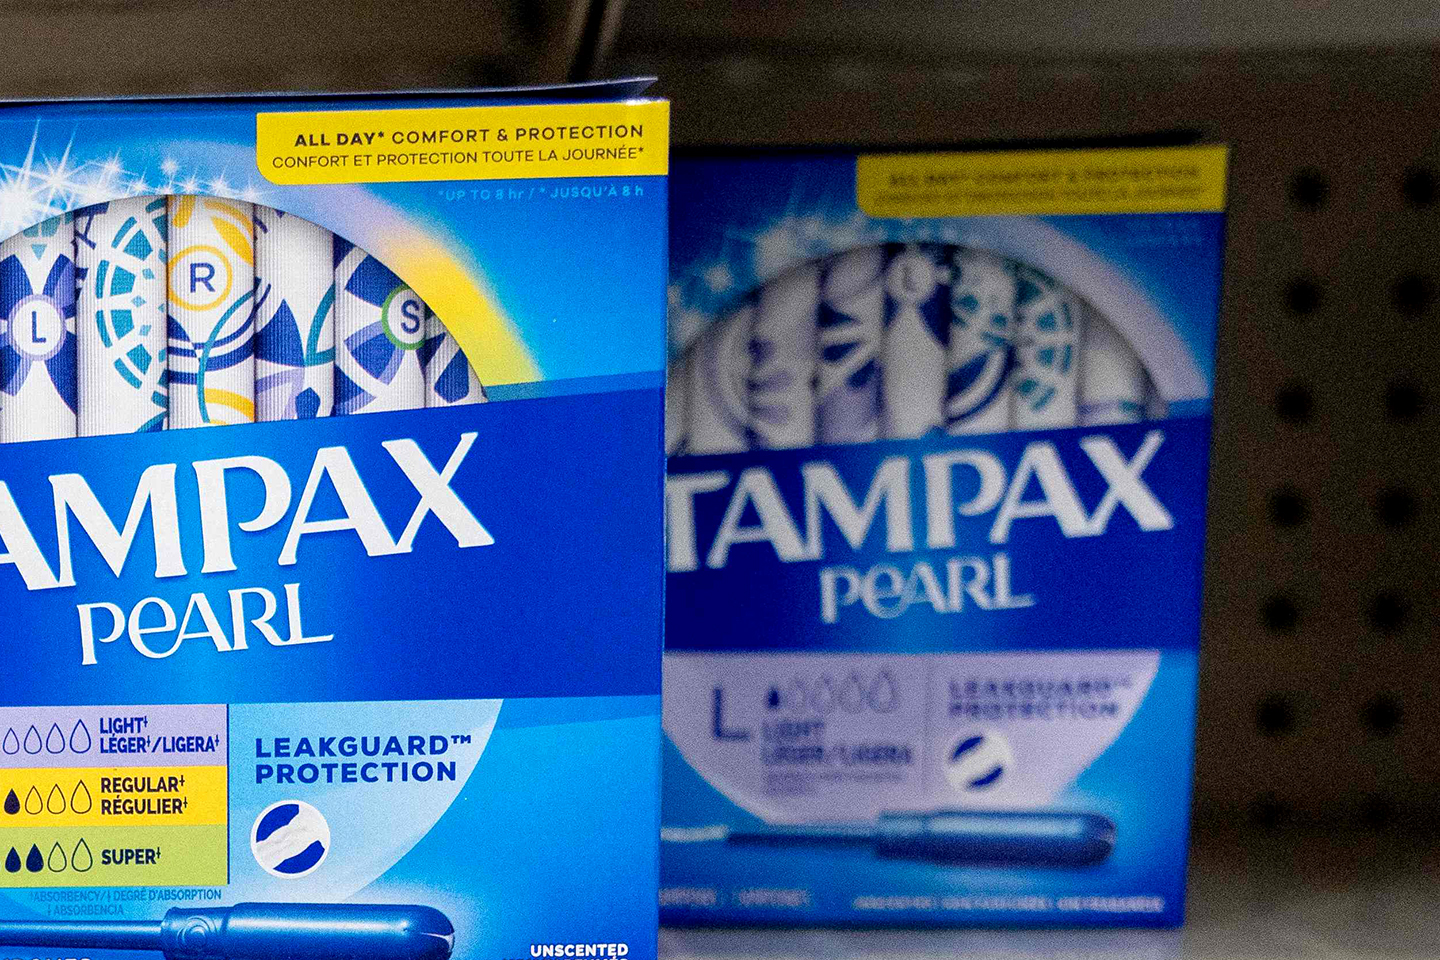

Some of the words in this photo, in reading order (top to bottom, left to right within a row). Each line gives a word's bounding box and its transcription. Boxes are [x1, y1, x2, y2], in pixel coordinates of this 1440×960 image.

[294, 132, 331, 147] ALL
[392, 128, 488, 145] COMFORT
[496, 127, 509, 142] &
[515, 124, 644, 141] PROTECTION
[272, 153, 348, 169] CONFORT
[353, 153, 372, 167] ET
[376, 150, 478, 167] PROTECTION
[482, 149, 534, 164] TOUTE
[539, 148, 559, 162] LA
[471, 189, 491, 201] TO
[495, 189, 504, 200] 8
[508, 188, 524, 199] hr
[622, 185, 631, 197] 8
[634, 184, 644, 196] h
[189, 263, 216, 292] R
[32, 310, 46, 343] L
[401, 298, 421, 335] S
[255, 760, 457, 785] PROTECTION
[530, 943, 628, 957] UNSCENTED
